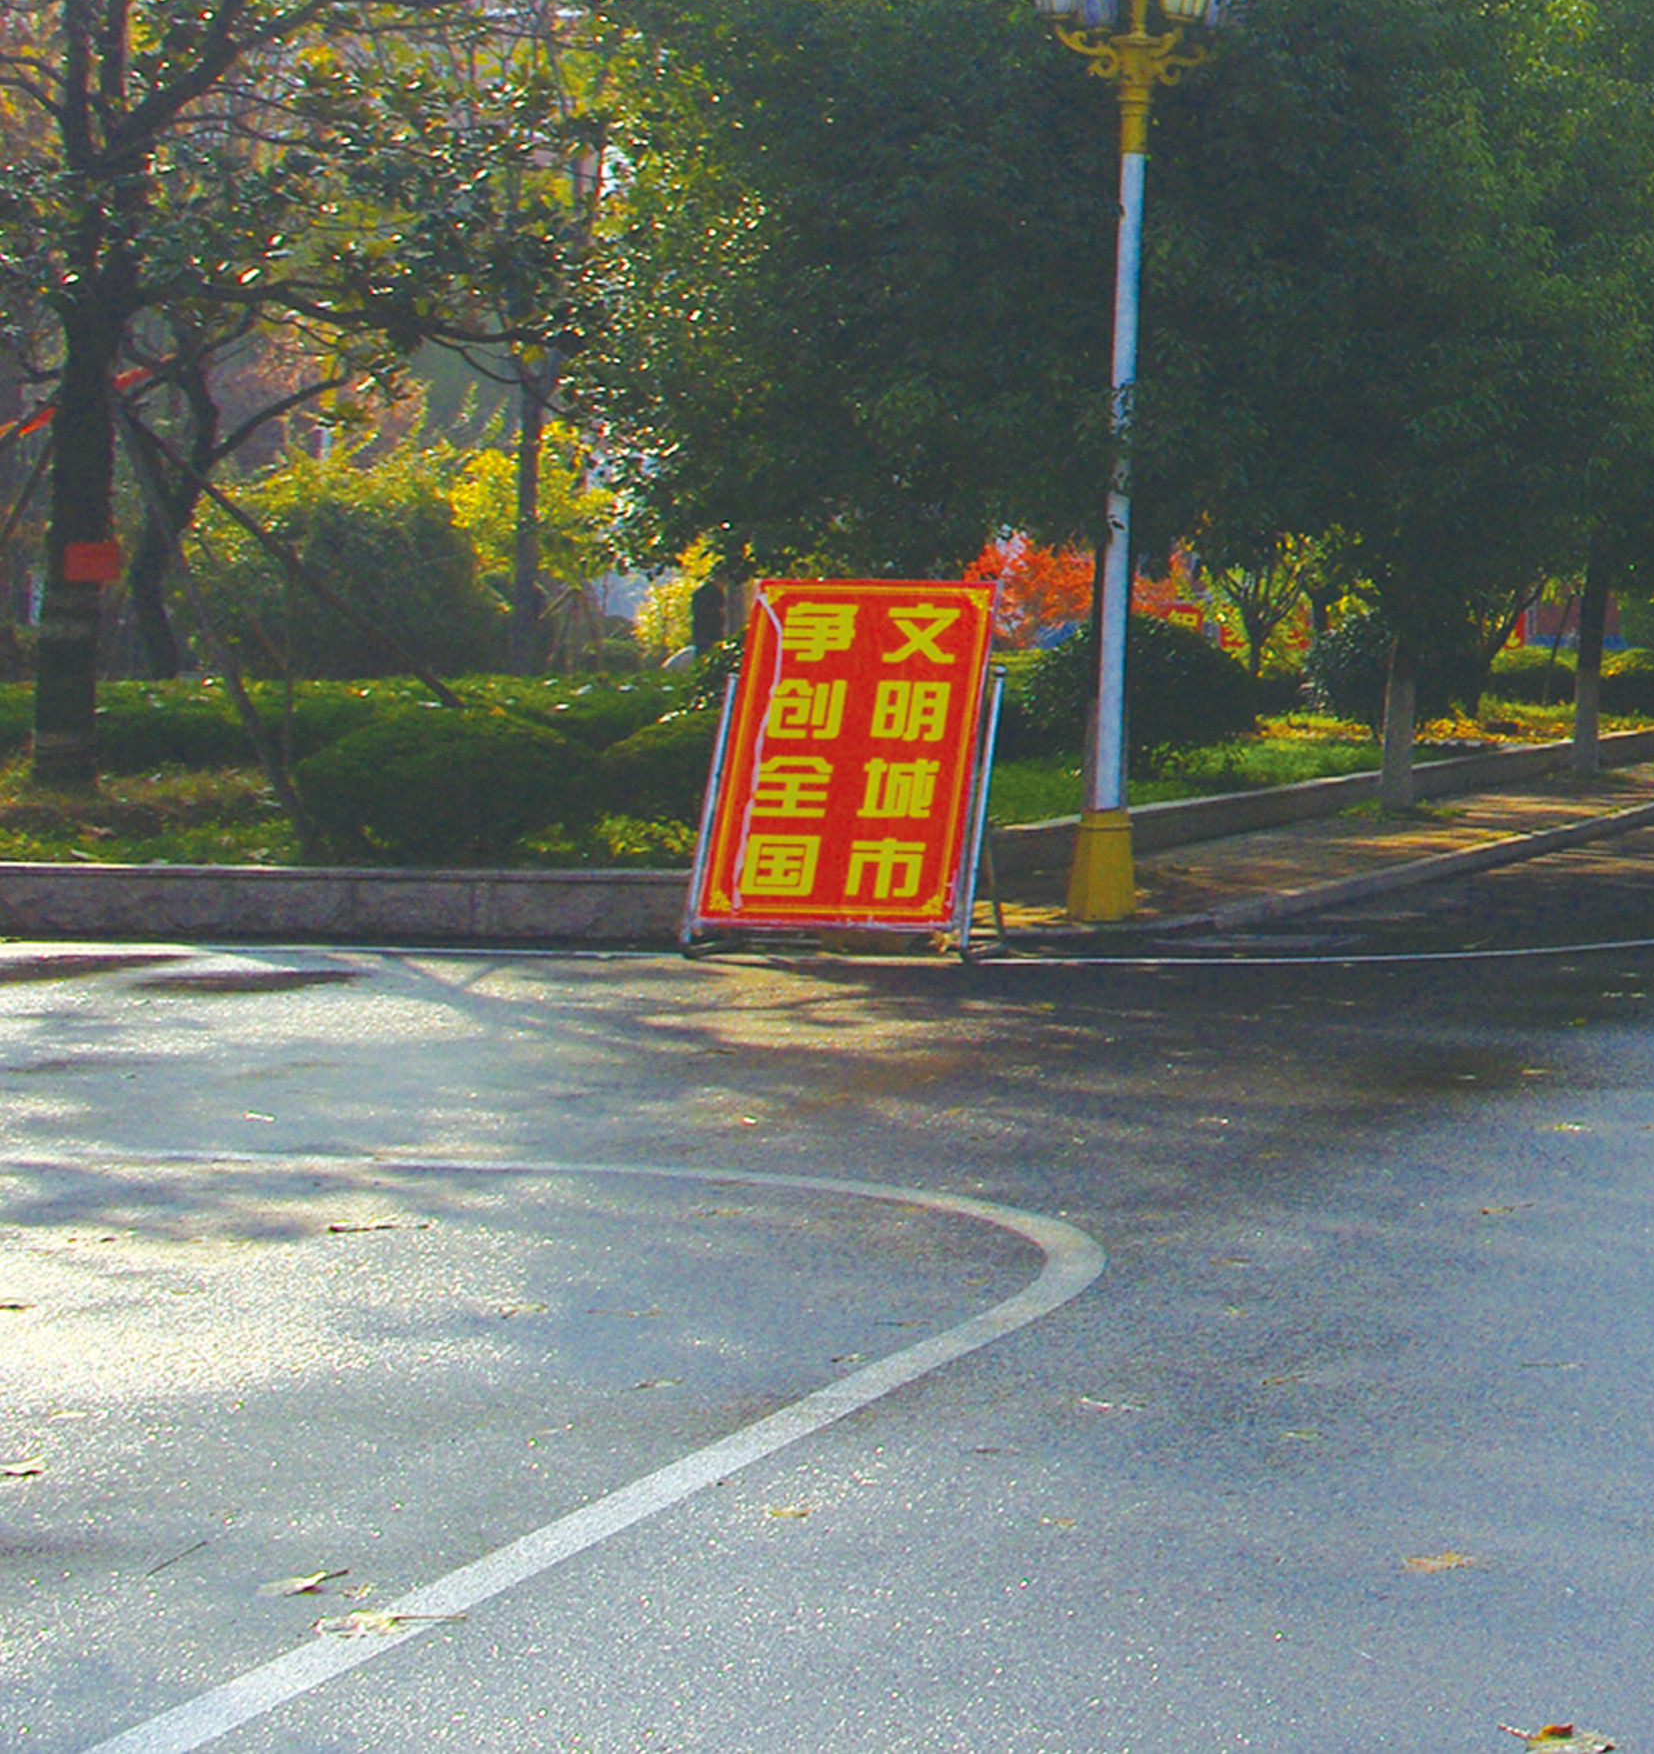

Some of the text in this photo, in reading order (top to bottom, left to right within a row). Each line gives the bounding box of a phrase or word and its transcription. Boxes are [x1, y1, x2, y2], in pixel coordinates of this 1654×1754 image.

[739, 601, 859, 897] 争创全国
[844, 602, 961, 900] 文明城市
